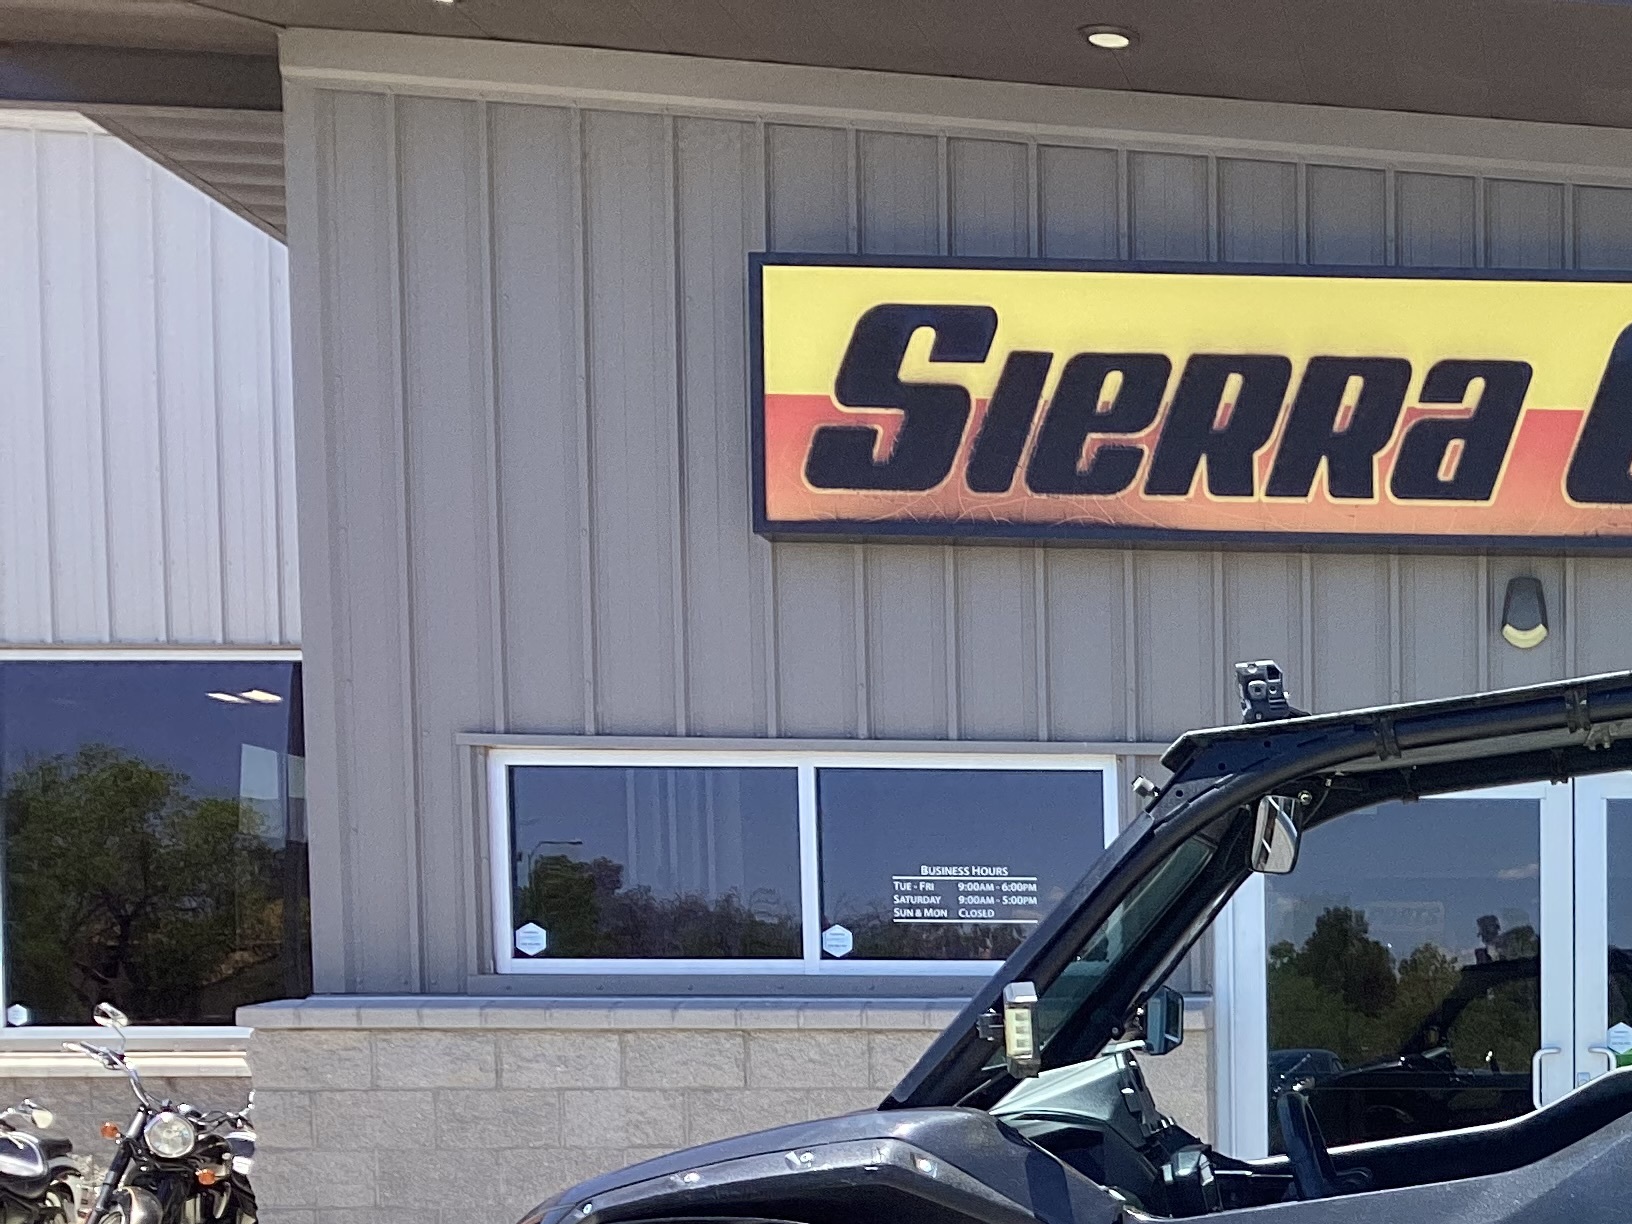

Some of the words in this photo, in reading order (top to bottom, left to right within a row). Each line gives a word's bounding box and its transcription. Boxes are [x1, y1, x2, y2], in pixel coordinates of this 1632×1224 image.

[920, 865, 970, 876] BUSINESS
[971, 865, 1008, 876] HOURS
[893, 881, 912, 891] TUE
[919, 881, 935, 891] FRI
[957, 882, 994, 892] 9:00AM
[1001, 882, 1037, 892] 6:00PM
[893, 895, 941, 905] SATURDAY
[957, 896, 994, 905] 9:00AM
[1001, 896, 1037, 905] 5:00PM
[893, 907, 914, 917] SUN
[923, 908, 948, 918] MON
[958, 908, 995, 918] CLOSED
